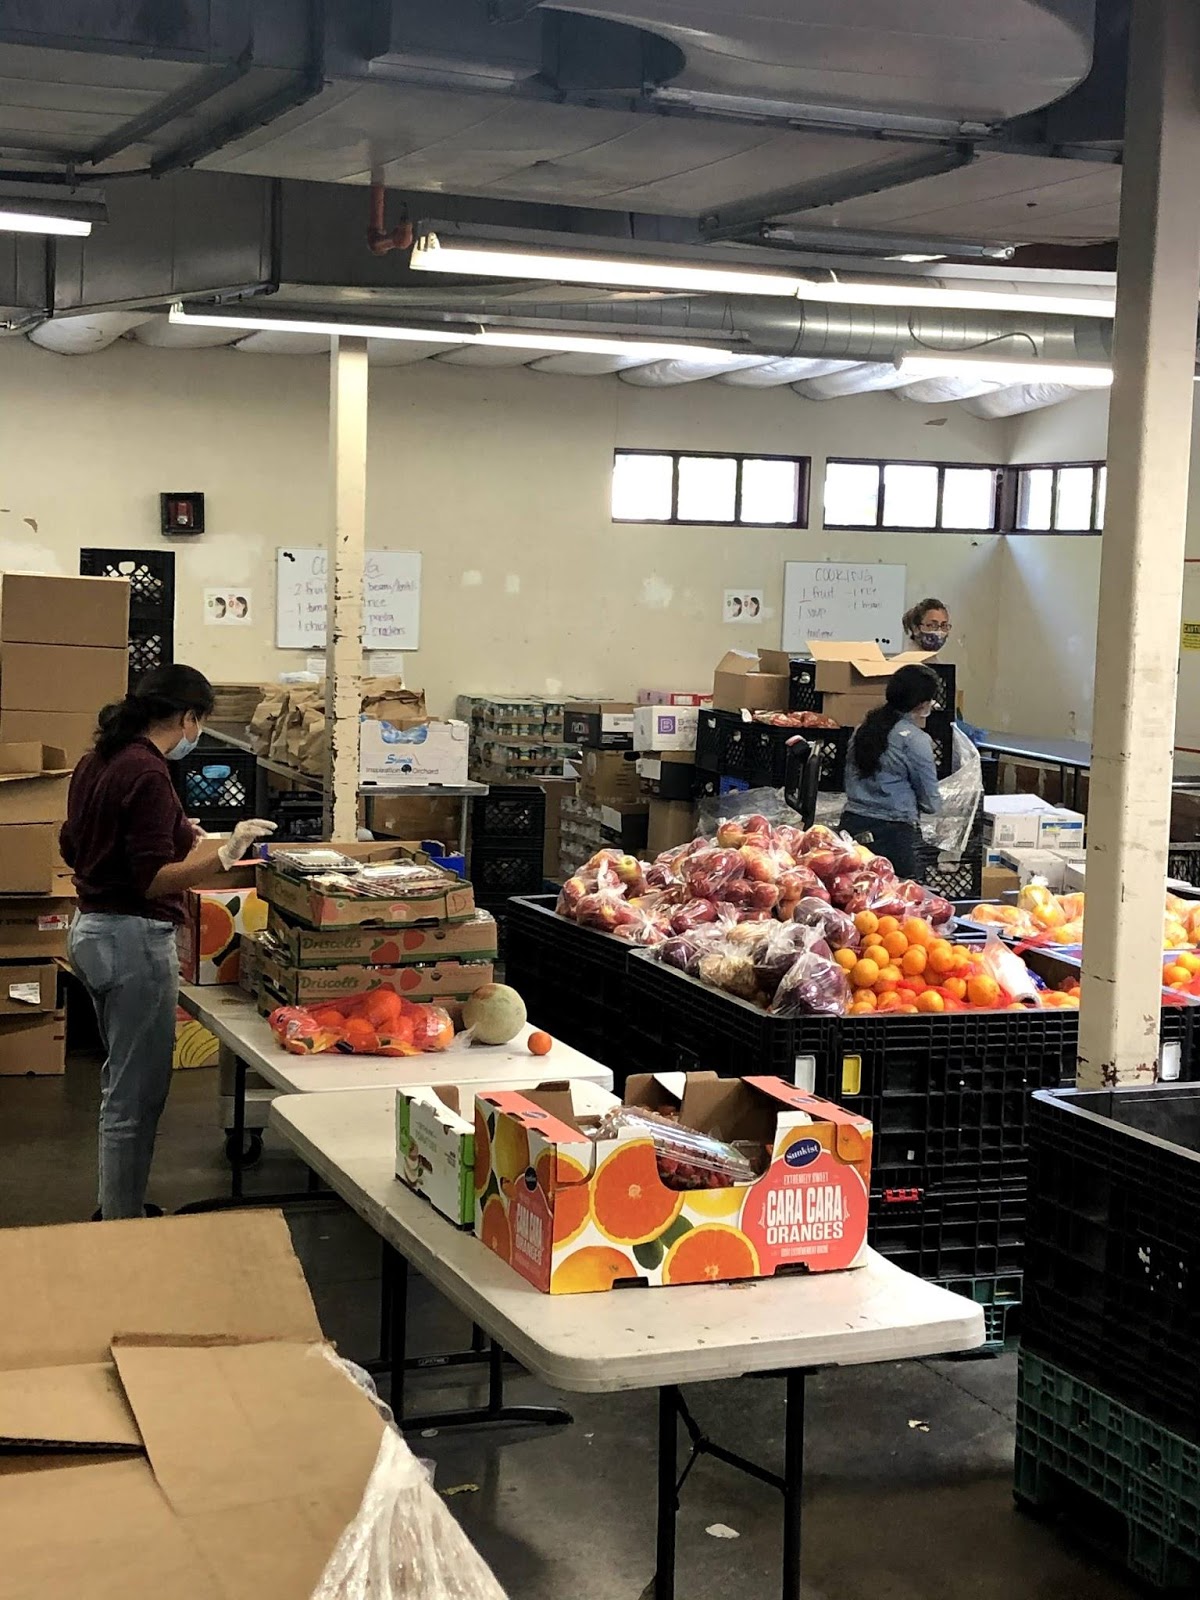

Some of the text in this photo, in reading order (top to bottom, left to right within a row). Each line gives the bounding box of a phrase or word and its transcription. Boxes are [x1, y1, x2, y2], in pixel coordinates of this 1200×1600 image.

[786, 1143, 819, 1162] Sunkist
[766, 1184, 843, 1227] CARA CARA
[766, 1220, 844, 1246] ORANGES
